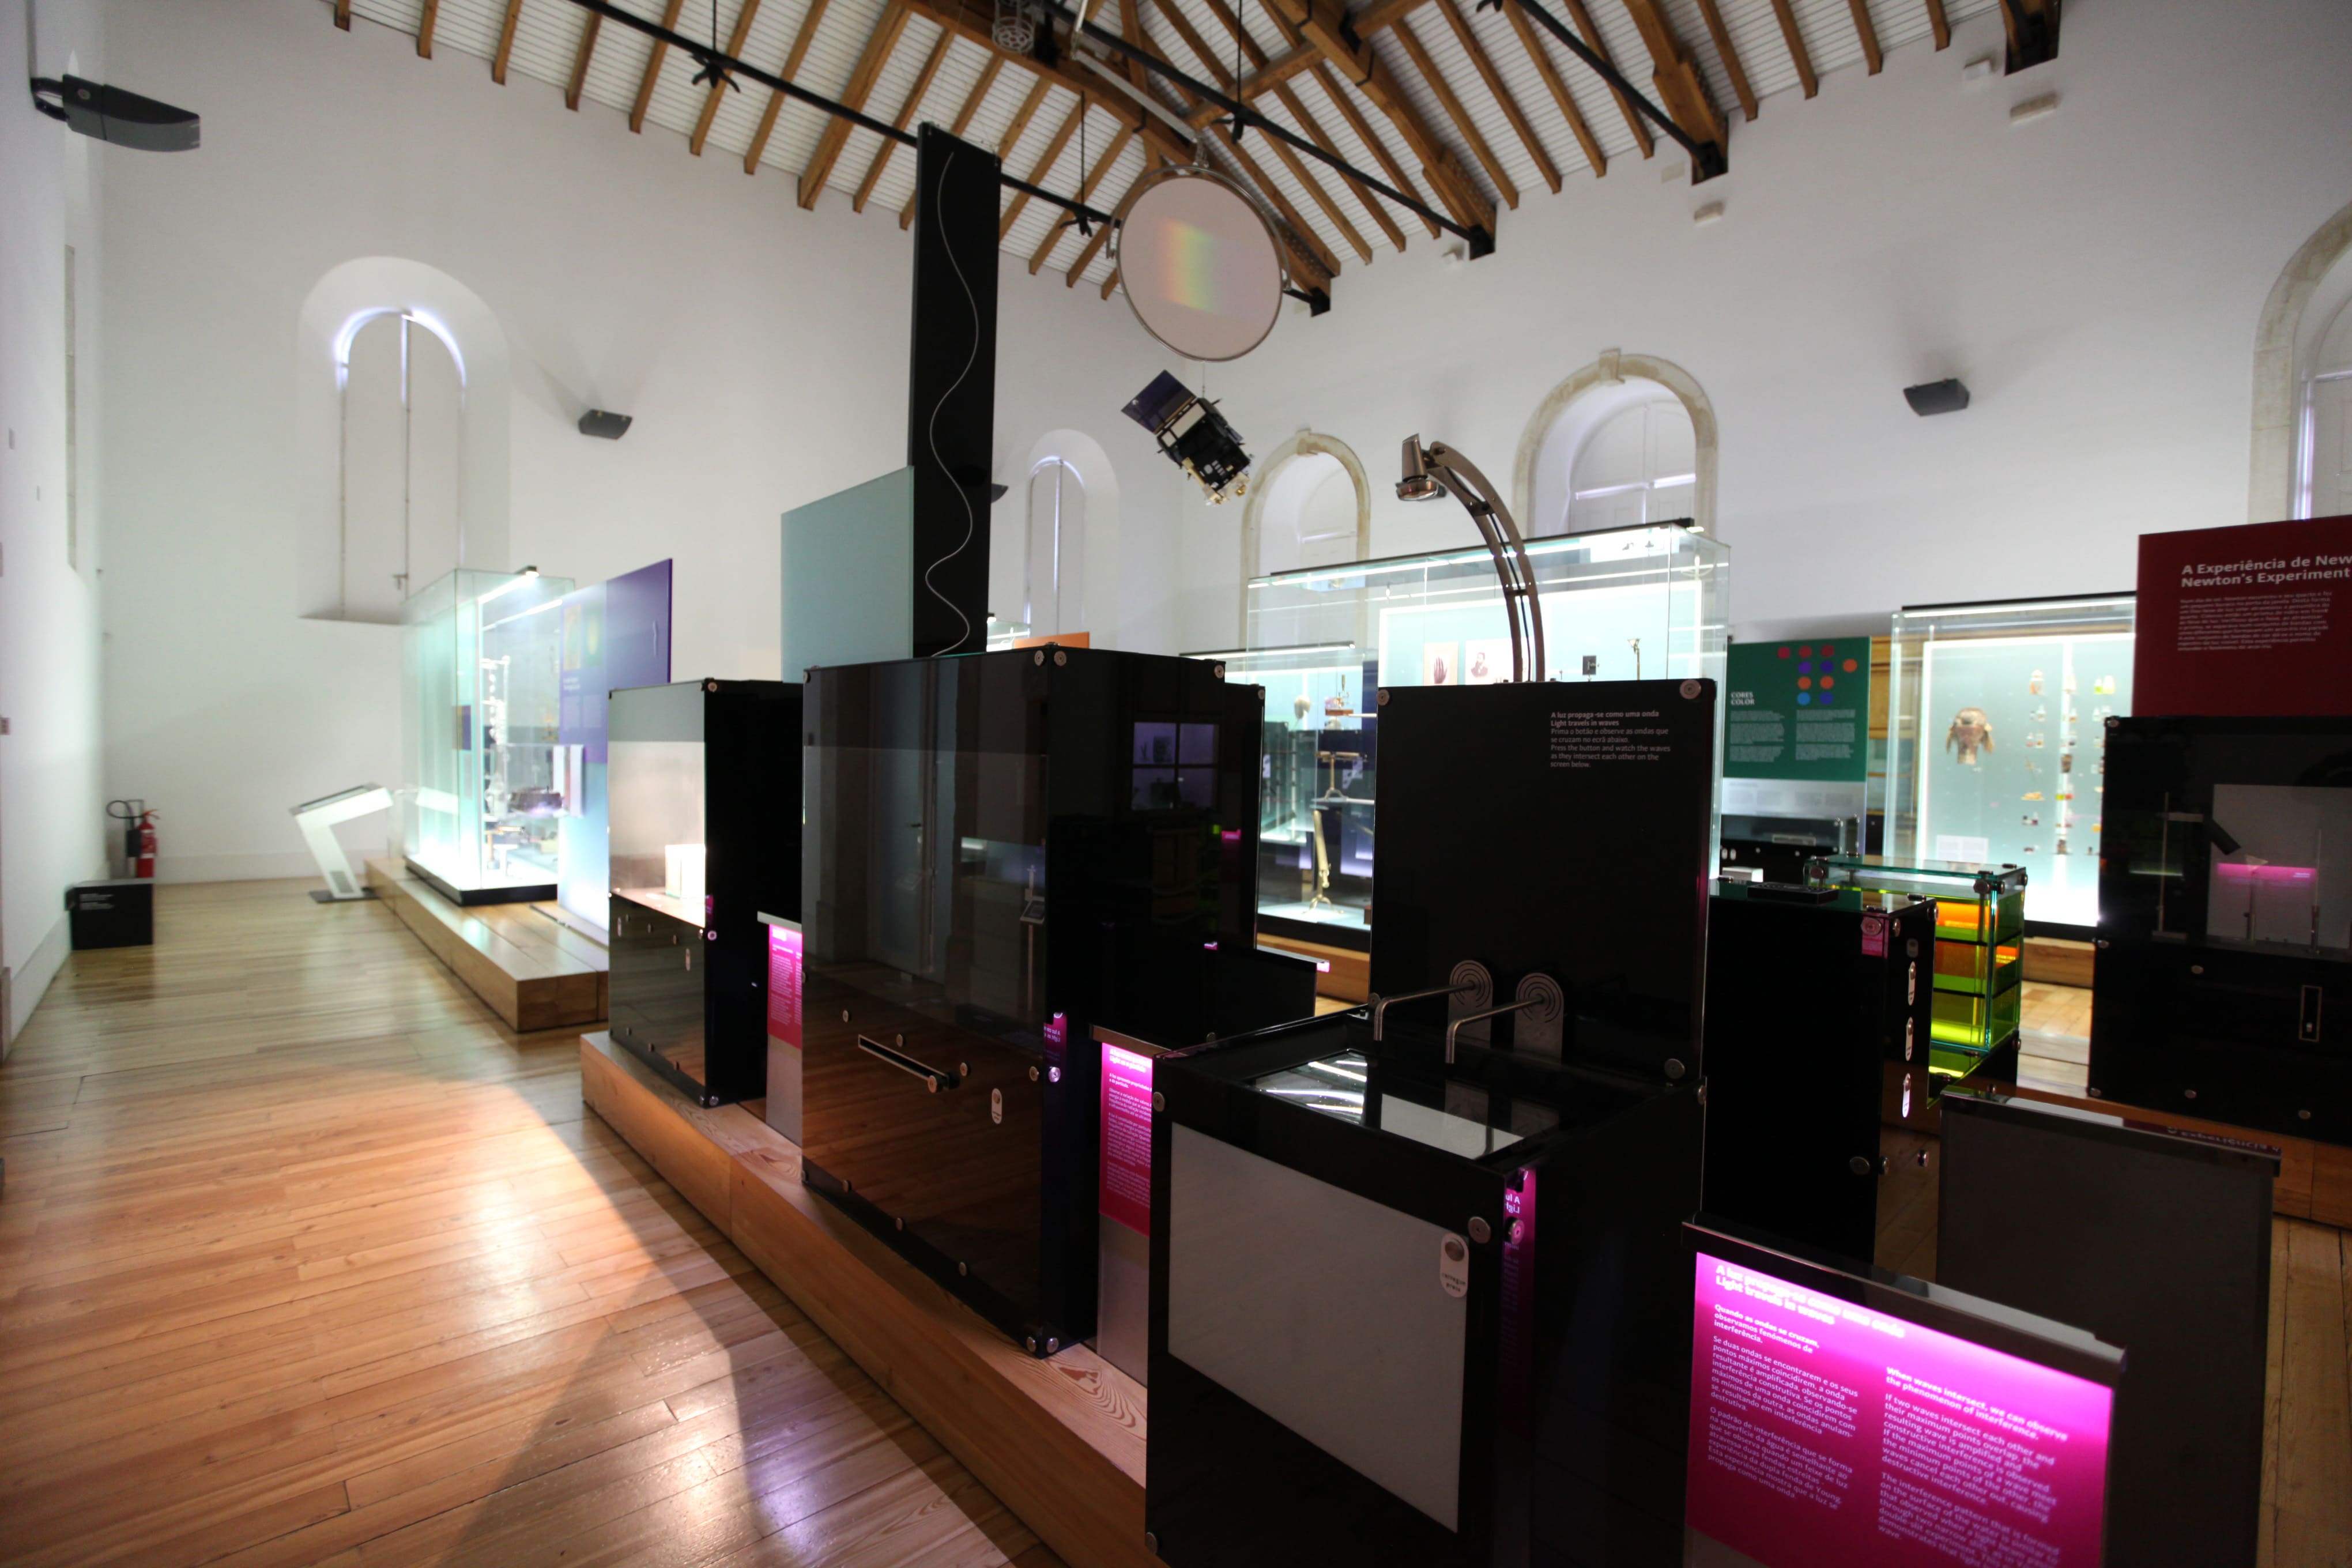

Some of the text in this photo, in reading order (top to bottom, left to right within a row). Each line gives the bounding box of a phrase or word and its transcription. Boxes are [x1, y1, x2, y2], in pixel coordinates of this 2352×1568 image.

[2181, 564, 2193, 575] A
[2197, 557, 2286, 575] Experiência
[2290, 556, 2310, 567] de
[2181, 567, 2350, 587] Newton's Experiment
[1714, 1304, 1743, 1318] Quando
[1754, 1320, 1777, 1331] ondas
[1714, 1311, 1812, 1353] observamos fenómenos de
[1713, 1345, 1736, 1358] pontos
[1739, 1355, 1769, 1370] máximos
[1825, 1389, 1844, 1400] onda
[1713, 1349, 1747, 1369] resultante
[1802, 1389, 1857, 1414] observando-se
[1713, 1359, 1757, 1381] interferência
[1825, 1406, 1851, 1420] pontos
[1723, 1340, 1739, 1350] duas
[1741, 1348, 1762, 1359] ondas
[1773, 1360, 1820, 1381] encontrarem
[1841, 1386, 1858, 1397] seus
[1886, 1376, 1900, 1386] the
[1902, 1384, 1961, 1409] phenomenon
[1712, 1369, 1742, 1384] máximos
[1755, 1386, 1770, 1395] uma
[1773, 1393, 1790, 1403] onda
[1793, 1401, 1836, 1422] coincidirem
[1839, 1420, 1855, 1430] com
[1721, 1380, 1750, 1395] mínimos
[1796, 1412, 1818, 1423] ondas
[1722, 1389, 1759, 1407] resultando
[1774, 1410, 1821, 1434] interferência
[1886, 1366, 1912, 1381] When
[1914, 1378, 1942, 1392] waves
[1990, 1407, 2004, 1416] we
[2007, 1414, 2025, 1423] can
[2027, 1421, 2068, 1441] observe
[1718, 1411, 1742, 1427] padrão
[1754, 1426, 1800, 1449] interferência
[1802, 1448, 1816, 1460] que
[1829, 1457, 1852, 1473] forma
[1884, 1412, 2021, 1471] resulting wave is amplified and
[1884, 1422, 1935, 1445] constructive
[1939, 1443, 1992, 1468] interference
[1885, 1403, 1904, 1414] their
[1908, 1413, 1950, 1432] maximum
[1953, 1431, 1980, 1449] points
[2023, 1457, 2038, 1468] the
[1894, 1397, 1910, 1408] two
[1913, 1405, 1938, 1419] waves
[1942, 1415, 1980, 1435] intersect
[1983, 1433, 2004, 1444] each
[2007, 1442, 2033, 1455] other
[2036, 1454, 2055, 1465] and
